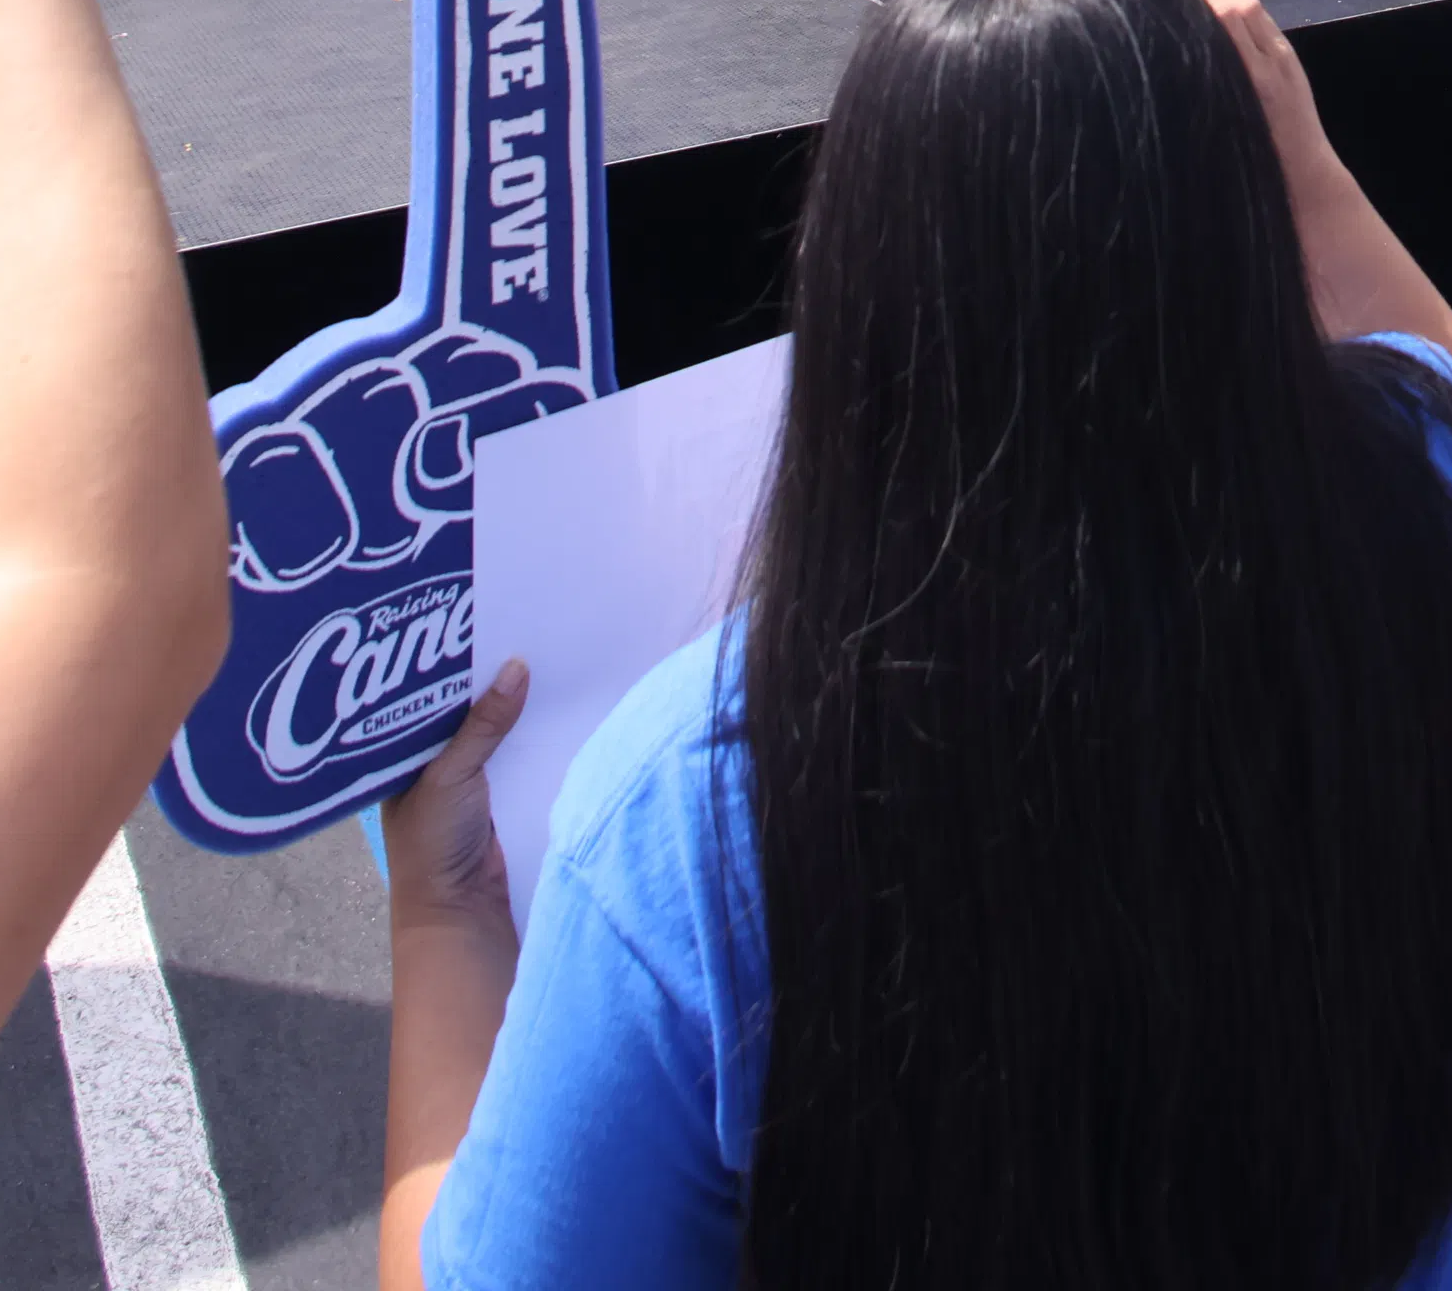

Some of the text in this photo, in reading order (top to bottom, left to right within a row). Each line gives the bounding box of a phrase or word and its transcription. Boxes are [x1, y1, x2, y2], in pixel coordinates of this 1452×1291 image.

[489, 108, 548, 305] LOVE
[367, 583, 459, 639] Raising
[266, 586, 473, 771] Cane
[363, 693, 434, 735] CHICKEN
